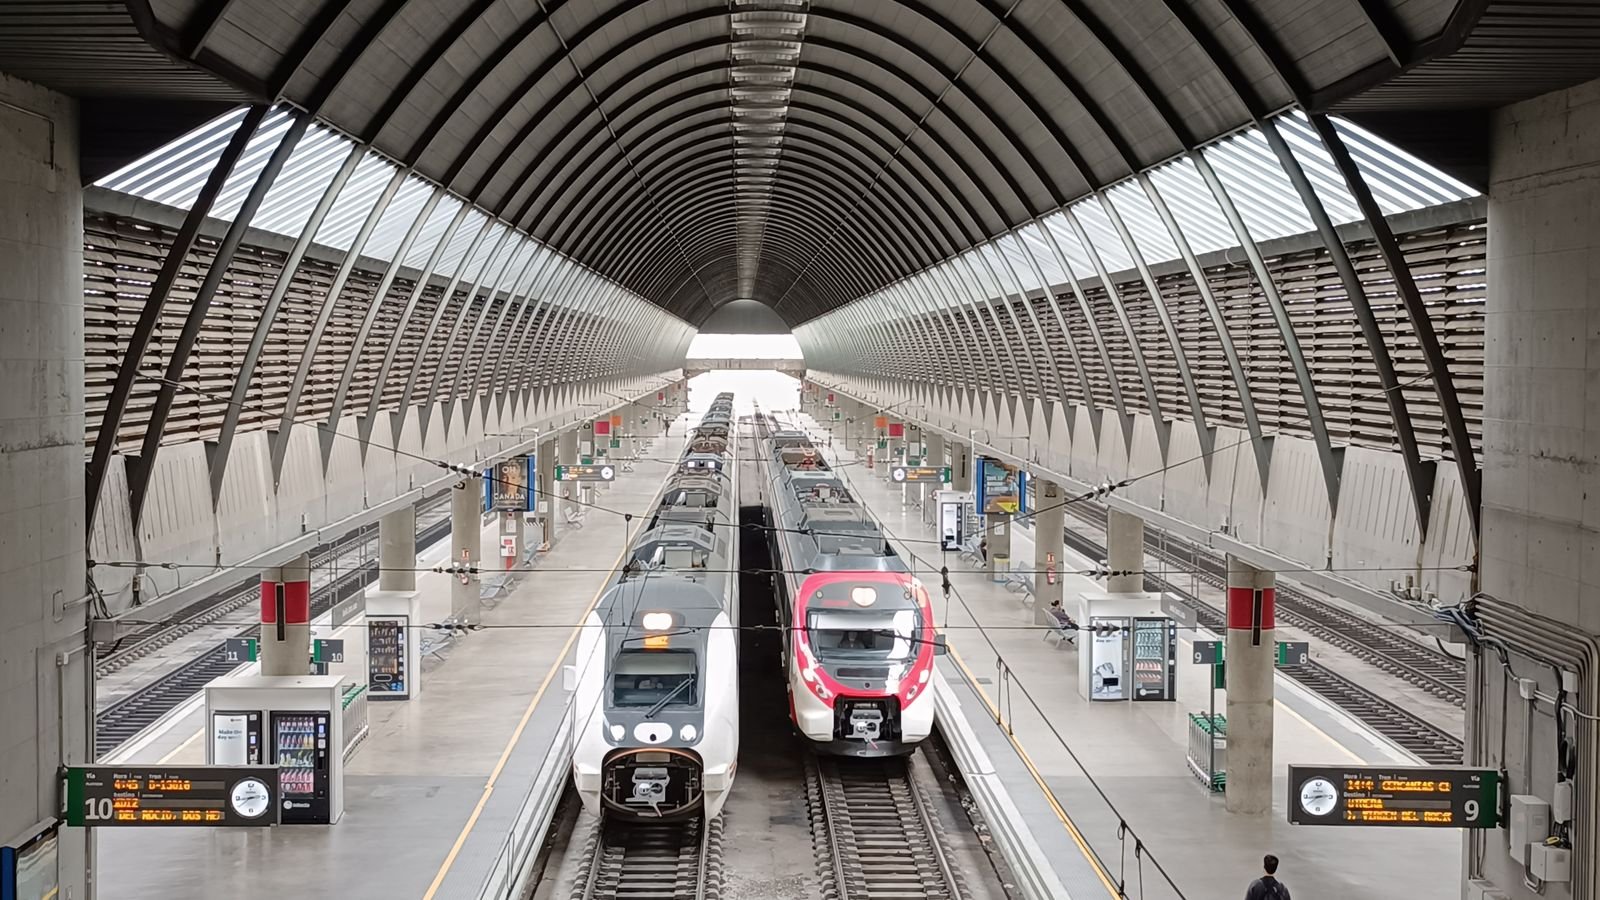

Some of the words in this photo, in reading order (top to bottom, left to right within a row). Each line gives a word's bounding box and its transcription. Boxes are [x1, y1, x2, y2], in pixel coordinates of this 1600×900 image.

[227, 651, 238, 661] 11
[331, 653, 342, 662] 10
[1194, 652, 1202, 663] 9
[1299, 653, 1307, 664] 8
[85, 798, 113, 820] 10
[1464, 800, 1479, 821] 9
